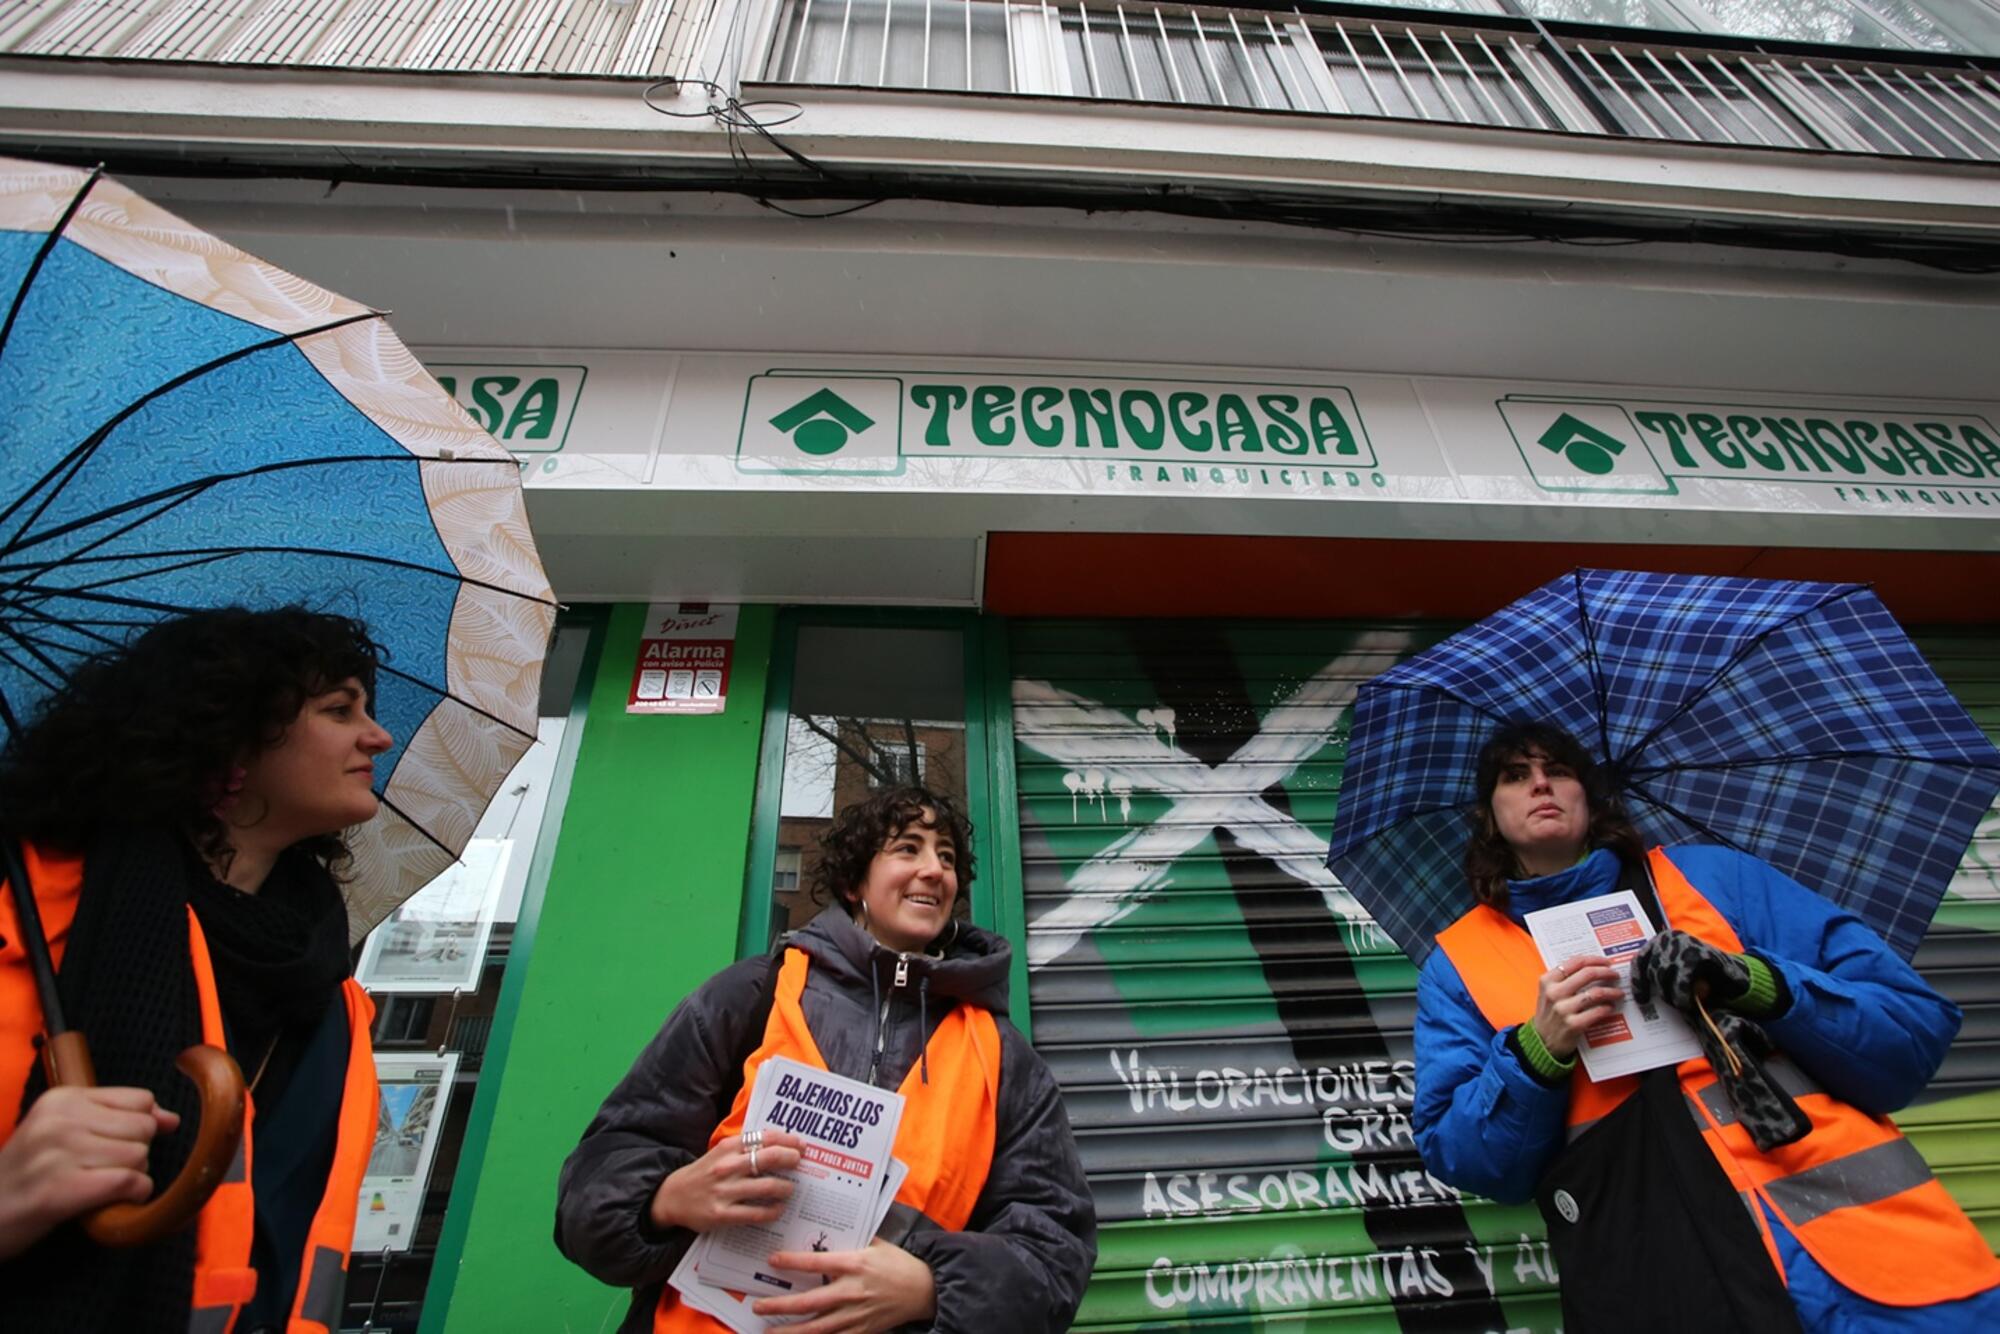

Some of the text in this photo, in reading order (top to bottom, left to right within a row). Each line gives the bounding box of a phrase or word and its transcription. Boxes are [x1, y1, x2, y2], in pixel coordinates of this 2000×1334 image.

[437, 376, 559, 439] SA
[911, 385, 1359, 455] TECNOCASA
[1634, 410, 2000, 479] TECNOCASA
[1107, 464, 1386, 488] FRANQUICIADO
[645, 643, 726, 659] Alarma
[775, 1073, 884, 1127] BAJEMOS LOS
[1110, 1049, 1416, 1114] VALORACIONES
[766, 1100, 864, 1149] ALQUILERES
[1322, 1103, 1416, 1152] GRA
[1142, 1163, 1482, 1219] ASESORAMIEN
[1145, 1245, 1454, 1309] COMPRAVENTAS
[1464, 1241, 1496, 1300] Y
